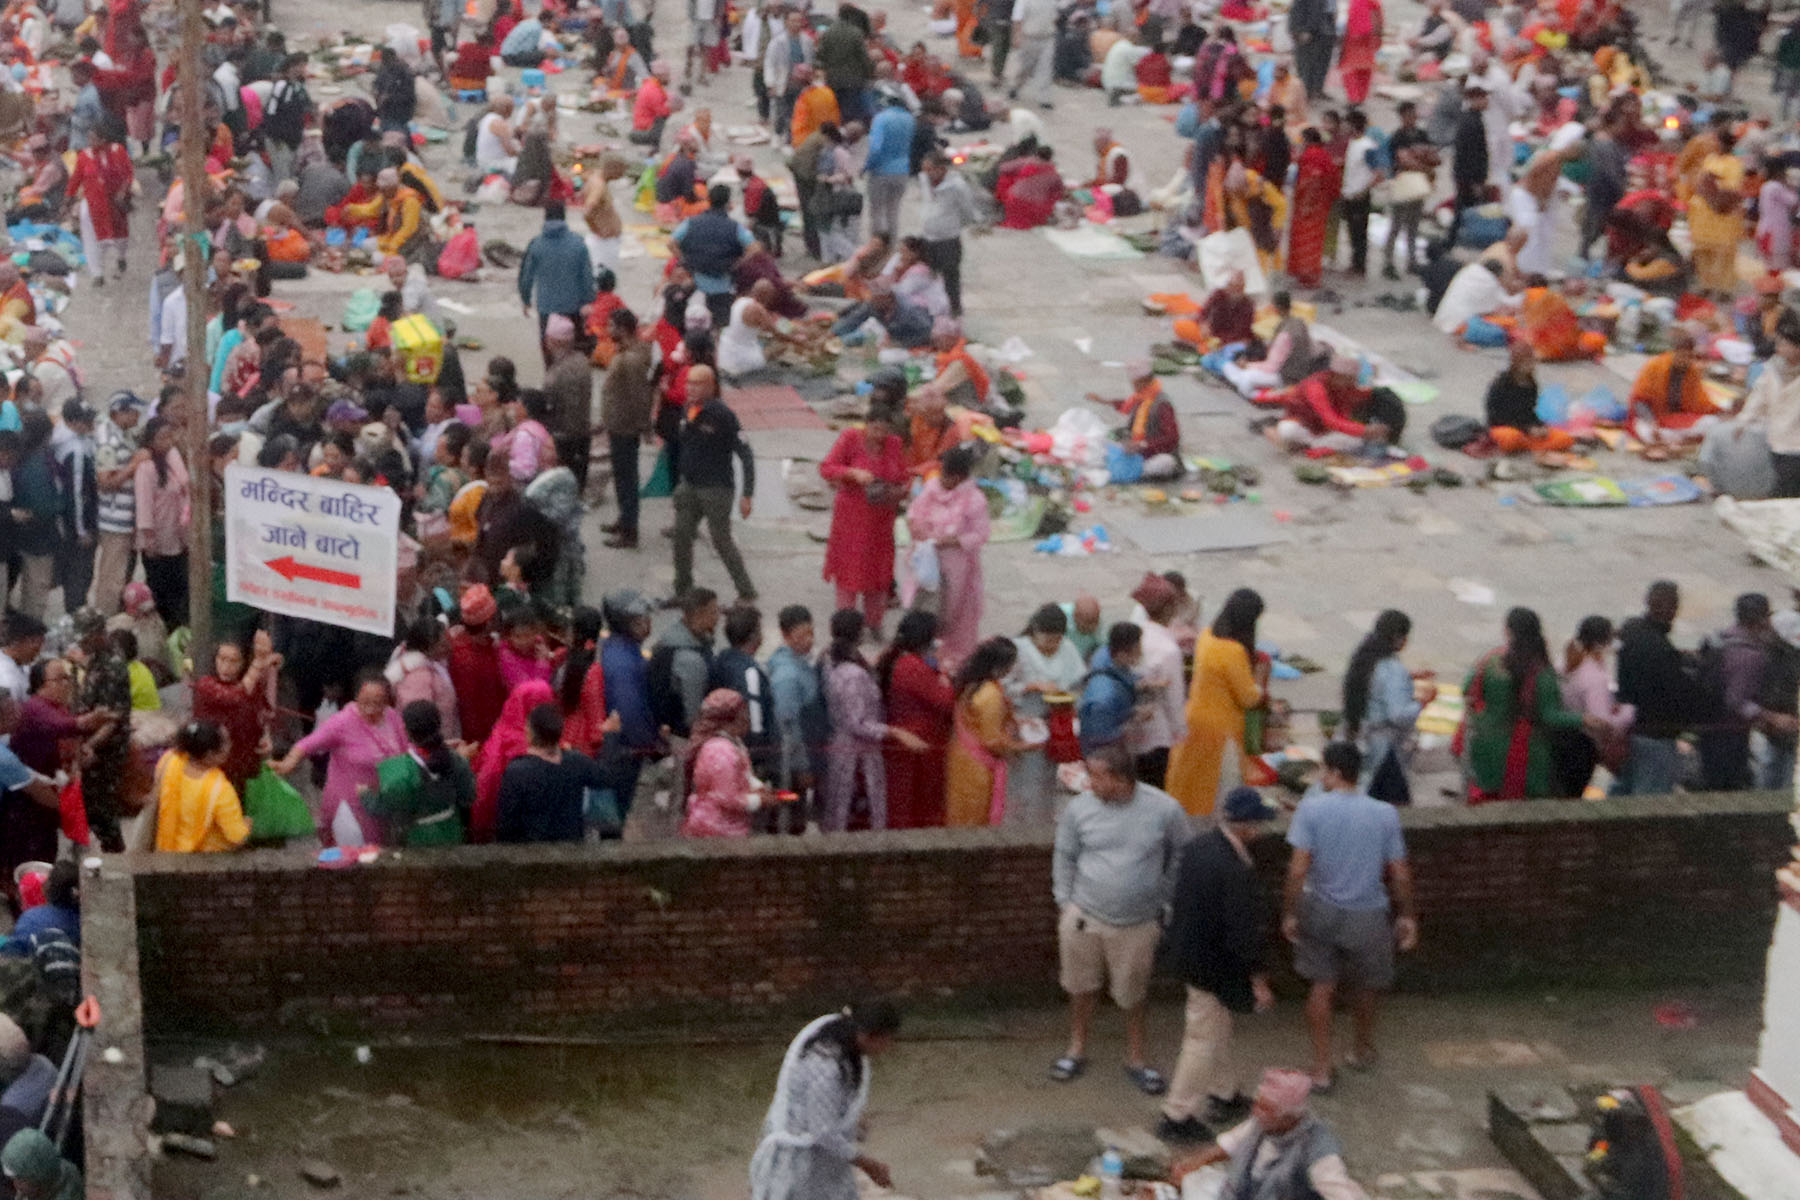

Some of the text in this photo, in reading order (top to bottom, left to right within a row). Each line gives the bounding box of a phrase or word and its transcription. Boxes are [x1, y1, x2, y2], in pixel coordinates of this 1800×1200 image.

[240, 478, 383, 525] मन्दिर बाहिर
[261, 523, 360, 560] जाने बाटो
